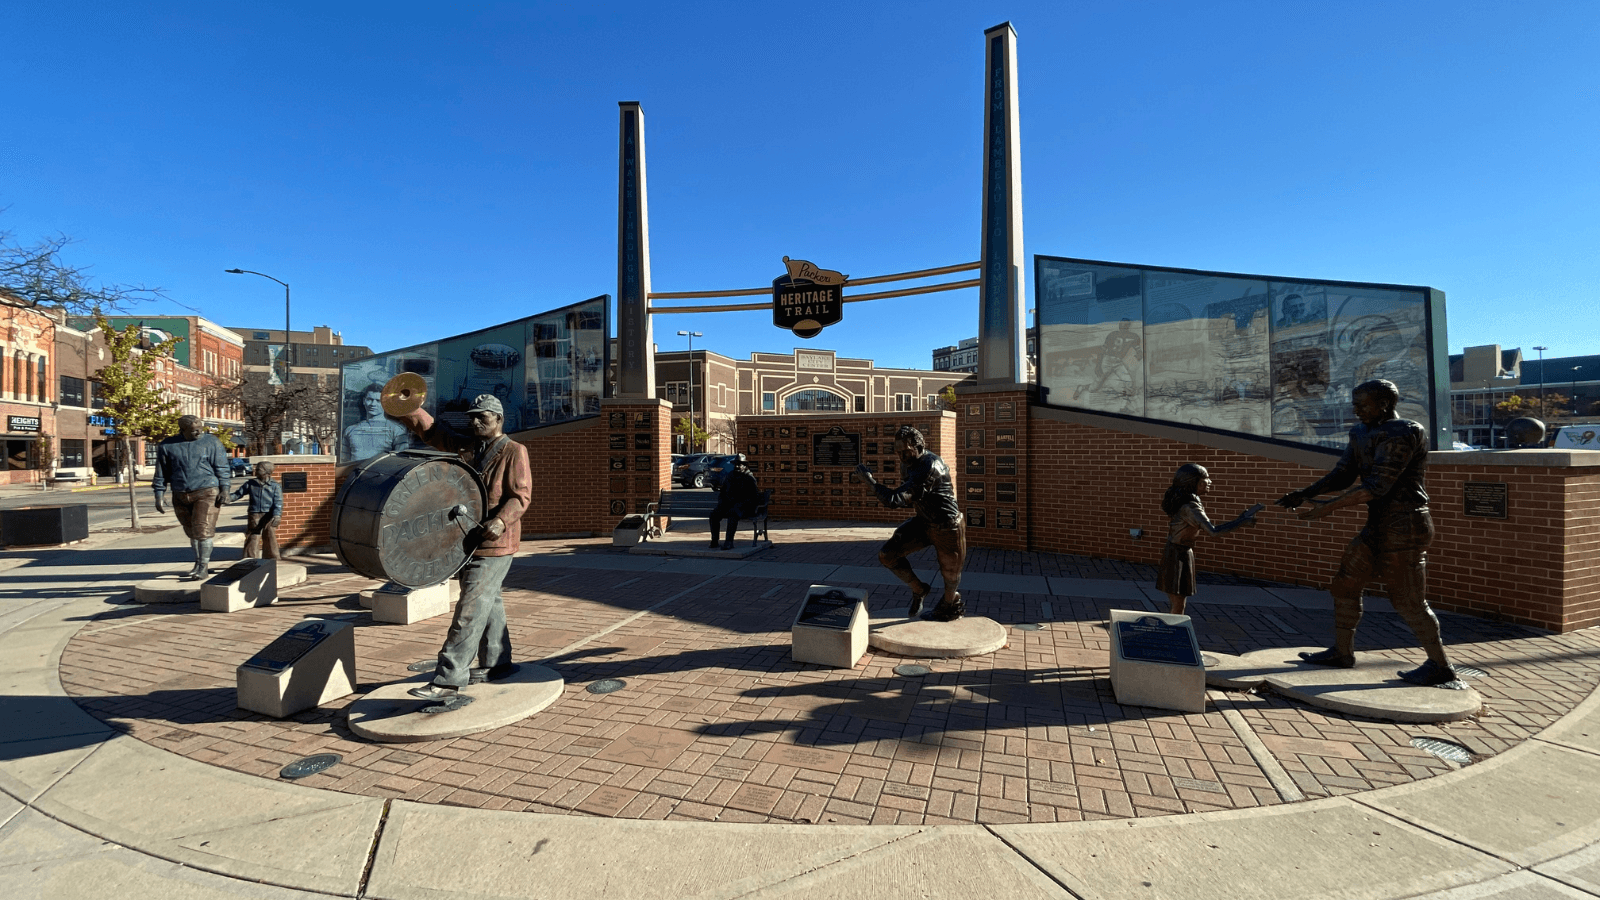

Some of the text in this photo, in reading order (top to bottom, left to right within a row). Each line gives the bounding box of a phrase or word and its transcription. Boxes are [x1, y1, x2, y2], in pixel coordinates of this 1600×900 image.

[626, 159, 634, 198] WALK
[993, 68, 1002, 330] FROM LAMBEAU TO LOMBARD
[626, 211, 634, 283] THROUGH
[798, 263, 832, 283] Packers
[781, 290, 833, 306] HERITAGE
[784, 304, 829, 317] TRAIL
[627, 297, 635, 369] HISTORY
[11, 416, 39, 426] HEIGHTS
[90, 415, 116, 426] FLAE
[385, 464, 443, 518] GREEN
[382, 500, 477, 548] PACKES
